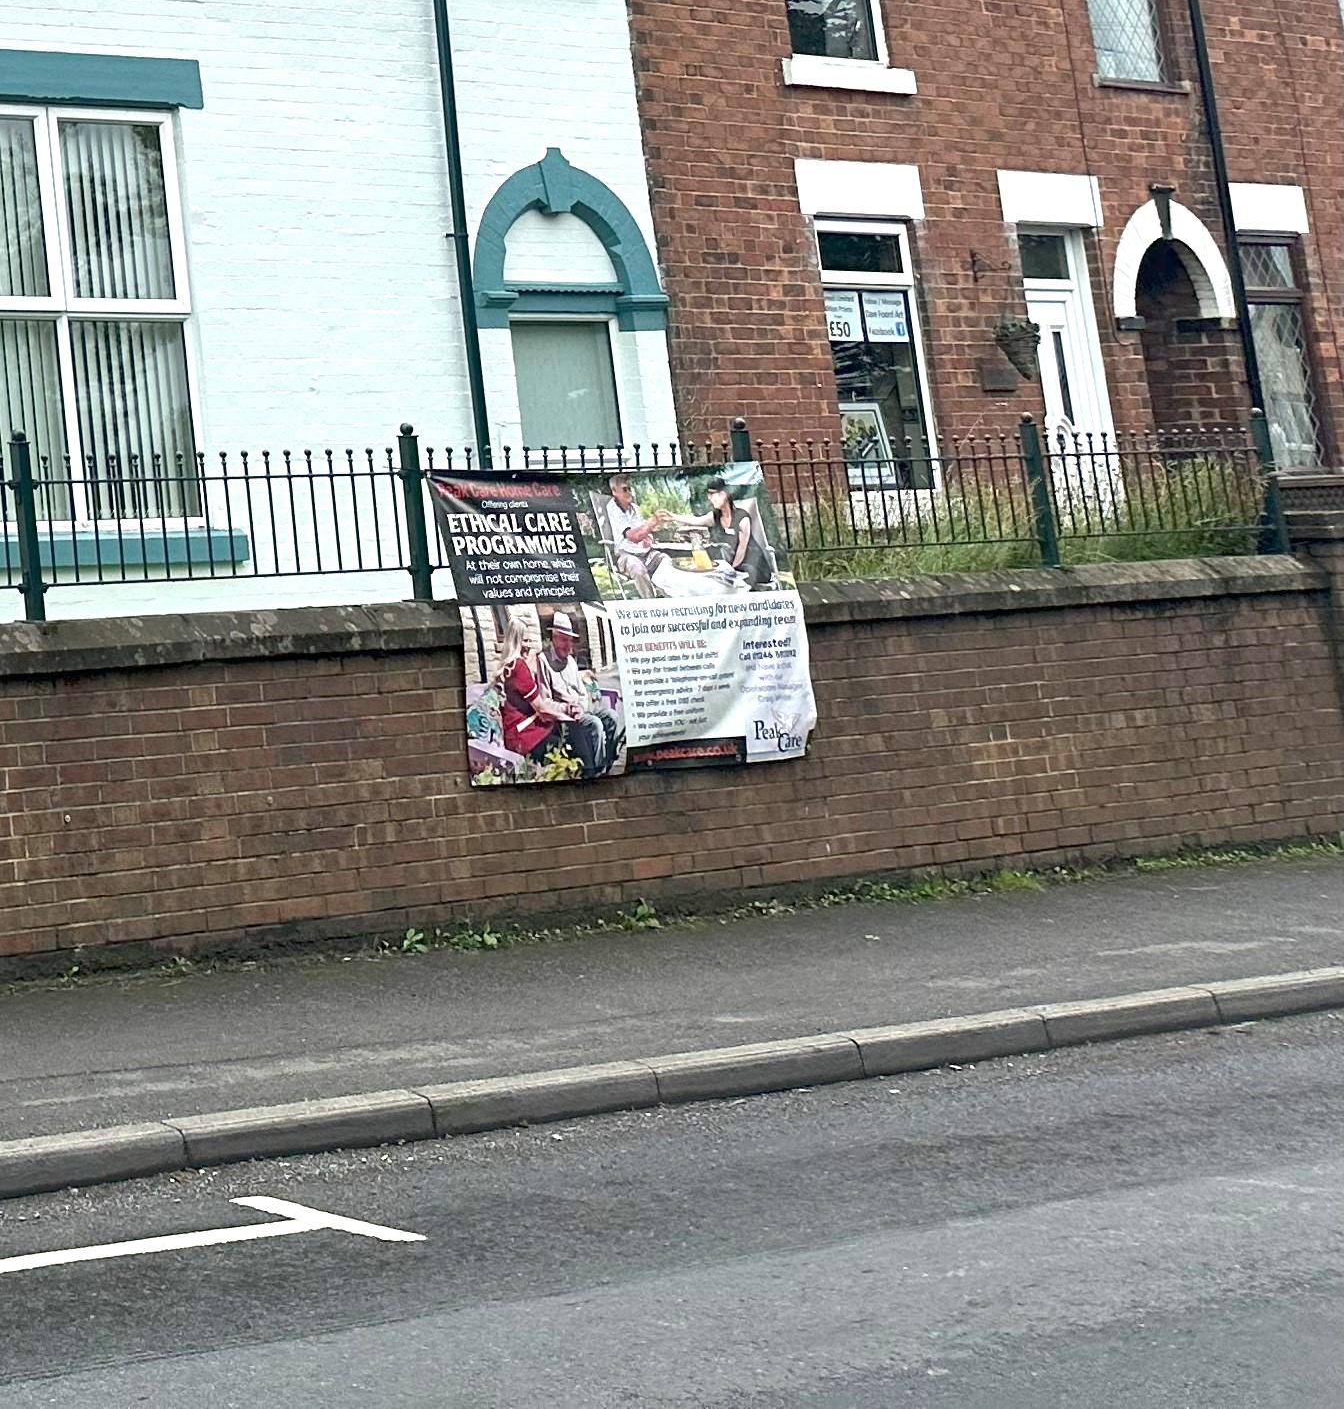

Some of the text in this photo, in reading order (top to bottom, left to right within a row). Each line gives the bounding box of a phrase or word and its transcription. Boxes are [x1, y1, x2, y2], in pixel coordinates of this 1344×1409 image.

[829, 321, 851, 337] £50
[435, 481, 561, 499] Peak Care Home Care
[481, 500, 529, 509] Offering clients
[446, 512, 572, 533] ETHICAL CARE
[451, 534, 577, 556] PROGRAMMES
[466, 560, 477, 570] At
[479, 559, 500, 570] their
[502, 560, 523, 570] own
[551, 559, 576, 569] which
[469, 572, 580, 586] will not compromise their
[482, 585, 576, 600] values and principles
[615, 599, 795, 620] We are now recruiting for new candidates
[620, 614, 796, 637] to join our successful and expanding team
[623, 639, 707, 654] YOUR BENEFITS WILL BE:
[738, 652, 751, 662] Call
[753, 720, 783, 740] Peak
[777, 732, 803, 752] Care
